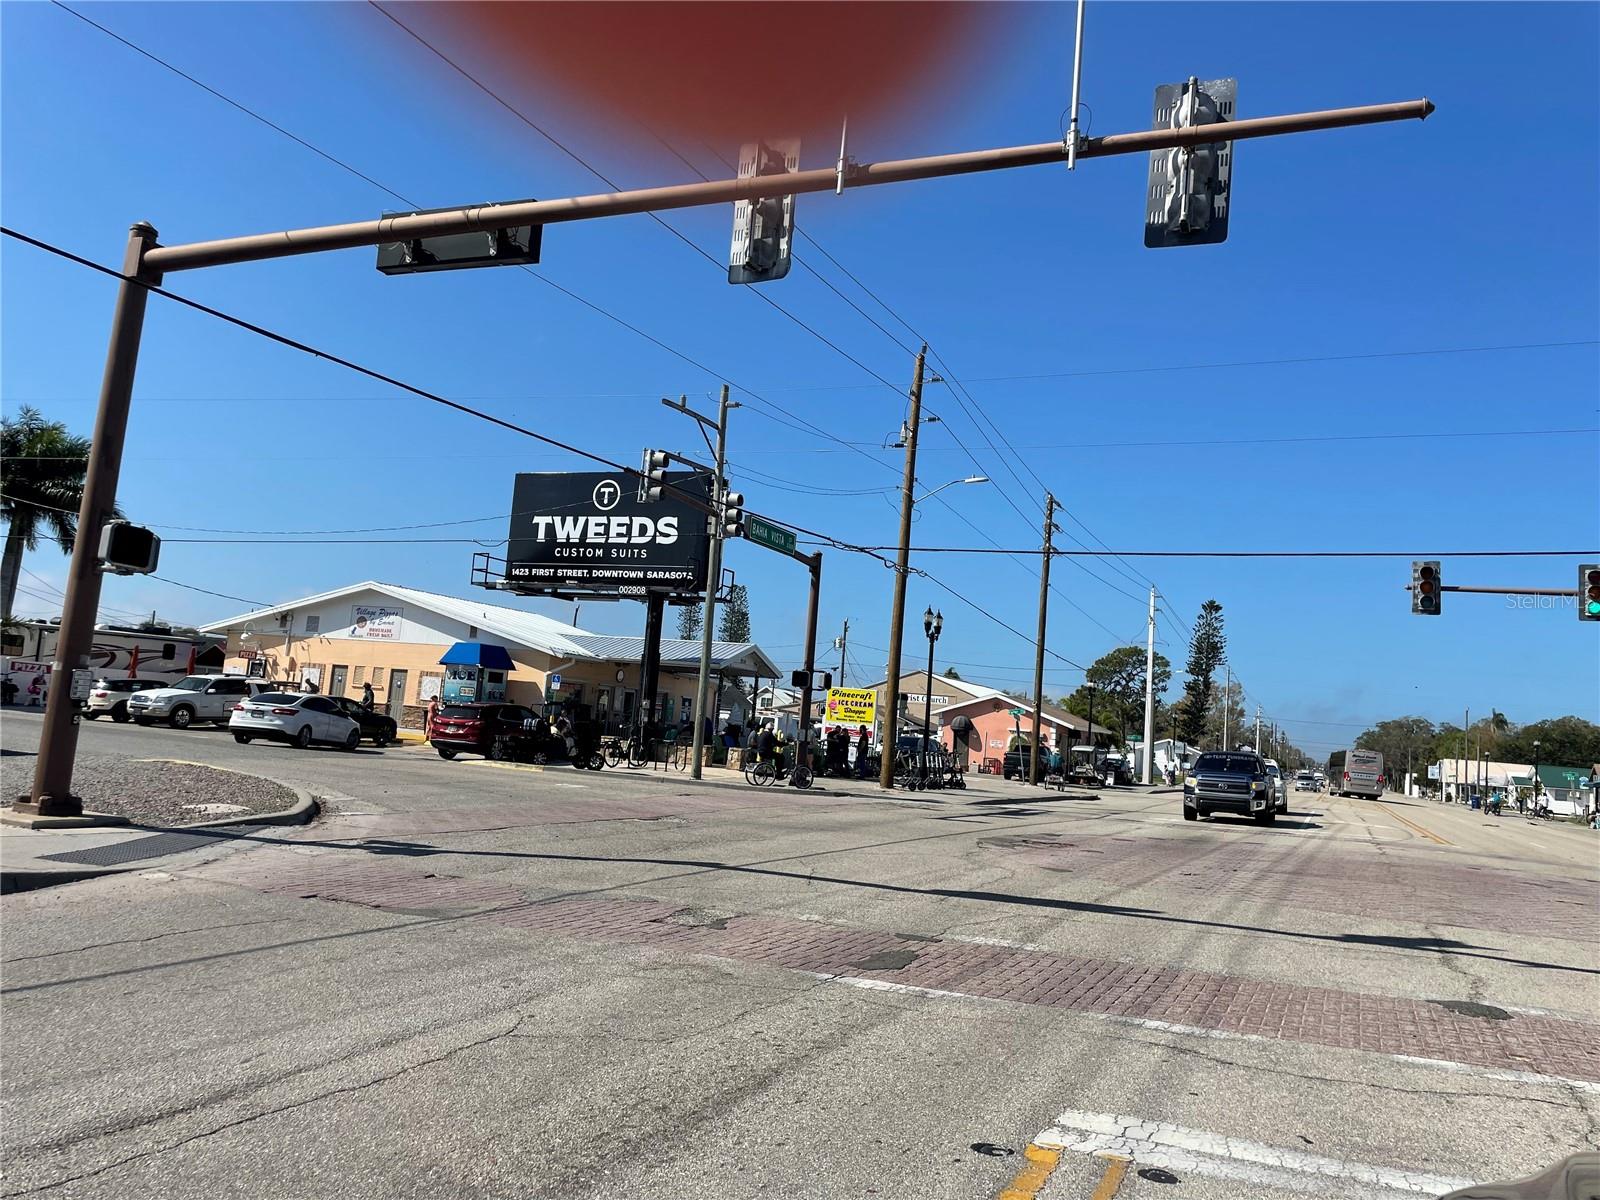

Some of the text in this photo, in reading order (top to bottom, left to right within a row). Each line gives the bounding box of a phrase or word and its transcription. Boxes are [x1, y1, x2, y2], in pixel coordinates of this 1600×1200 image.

[600, 487, 614, 505] T
[532, 515, 679, 545] TWEEDS
[752, 522, 768, 539] BAHIA
[771, 531, 785, 545] VISTA
[554, 547, 648, 558] CUSTOM SUITS
[512, 568, 694, 580] 1423 FIRST STREET, DOWNTOWN SARASOTA
[619, 585, 647, 595] 002908
[239, 650, 257, 660] PIZZA
[14, 661, 48, 674] PIZZA
[488, 690, 505, 700] ICE
[831, 688, 873, 700] Pinecraft
[922, 695, 947, 704] Curch
[838, 699, 874, 708] ICE CREAM
[843, 707, 867, 715] Shoppe
